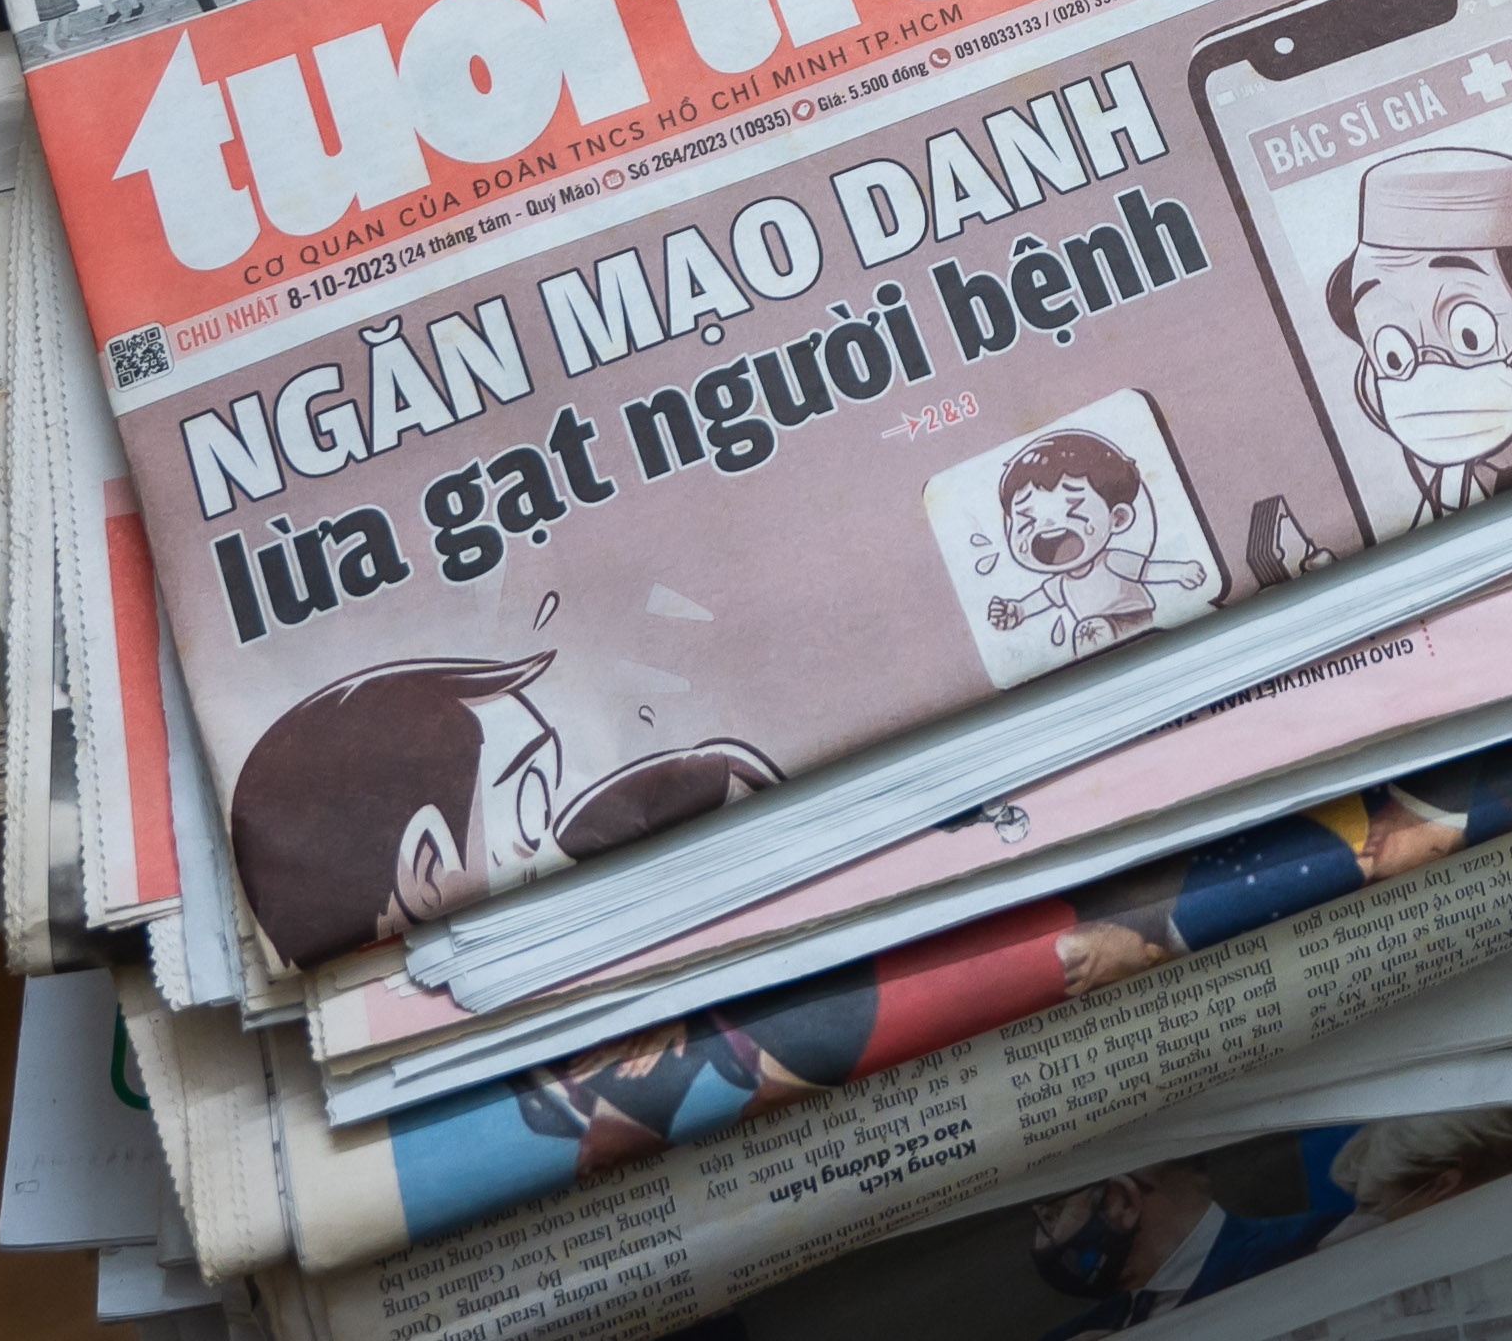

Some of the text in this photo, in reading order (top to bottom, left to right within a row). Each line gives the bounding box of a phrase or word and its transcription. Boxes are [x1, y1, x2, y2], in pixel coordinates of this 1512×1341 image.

[1263, 78, 1449, 175] BÁC SĨ GIẢ
[180, 59, 1172, 522] NGĂN MẠO DANH
[214, 188, 1209, 645] lừa gạt người bệnh
[996, 934, 1268, 1041] bên phản đối tấn công vào Gaza
